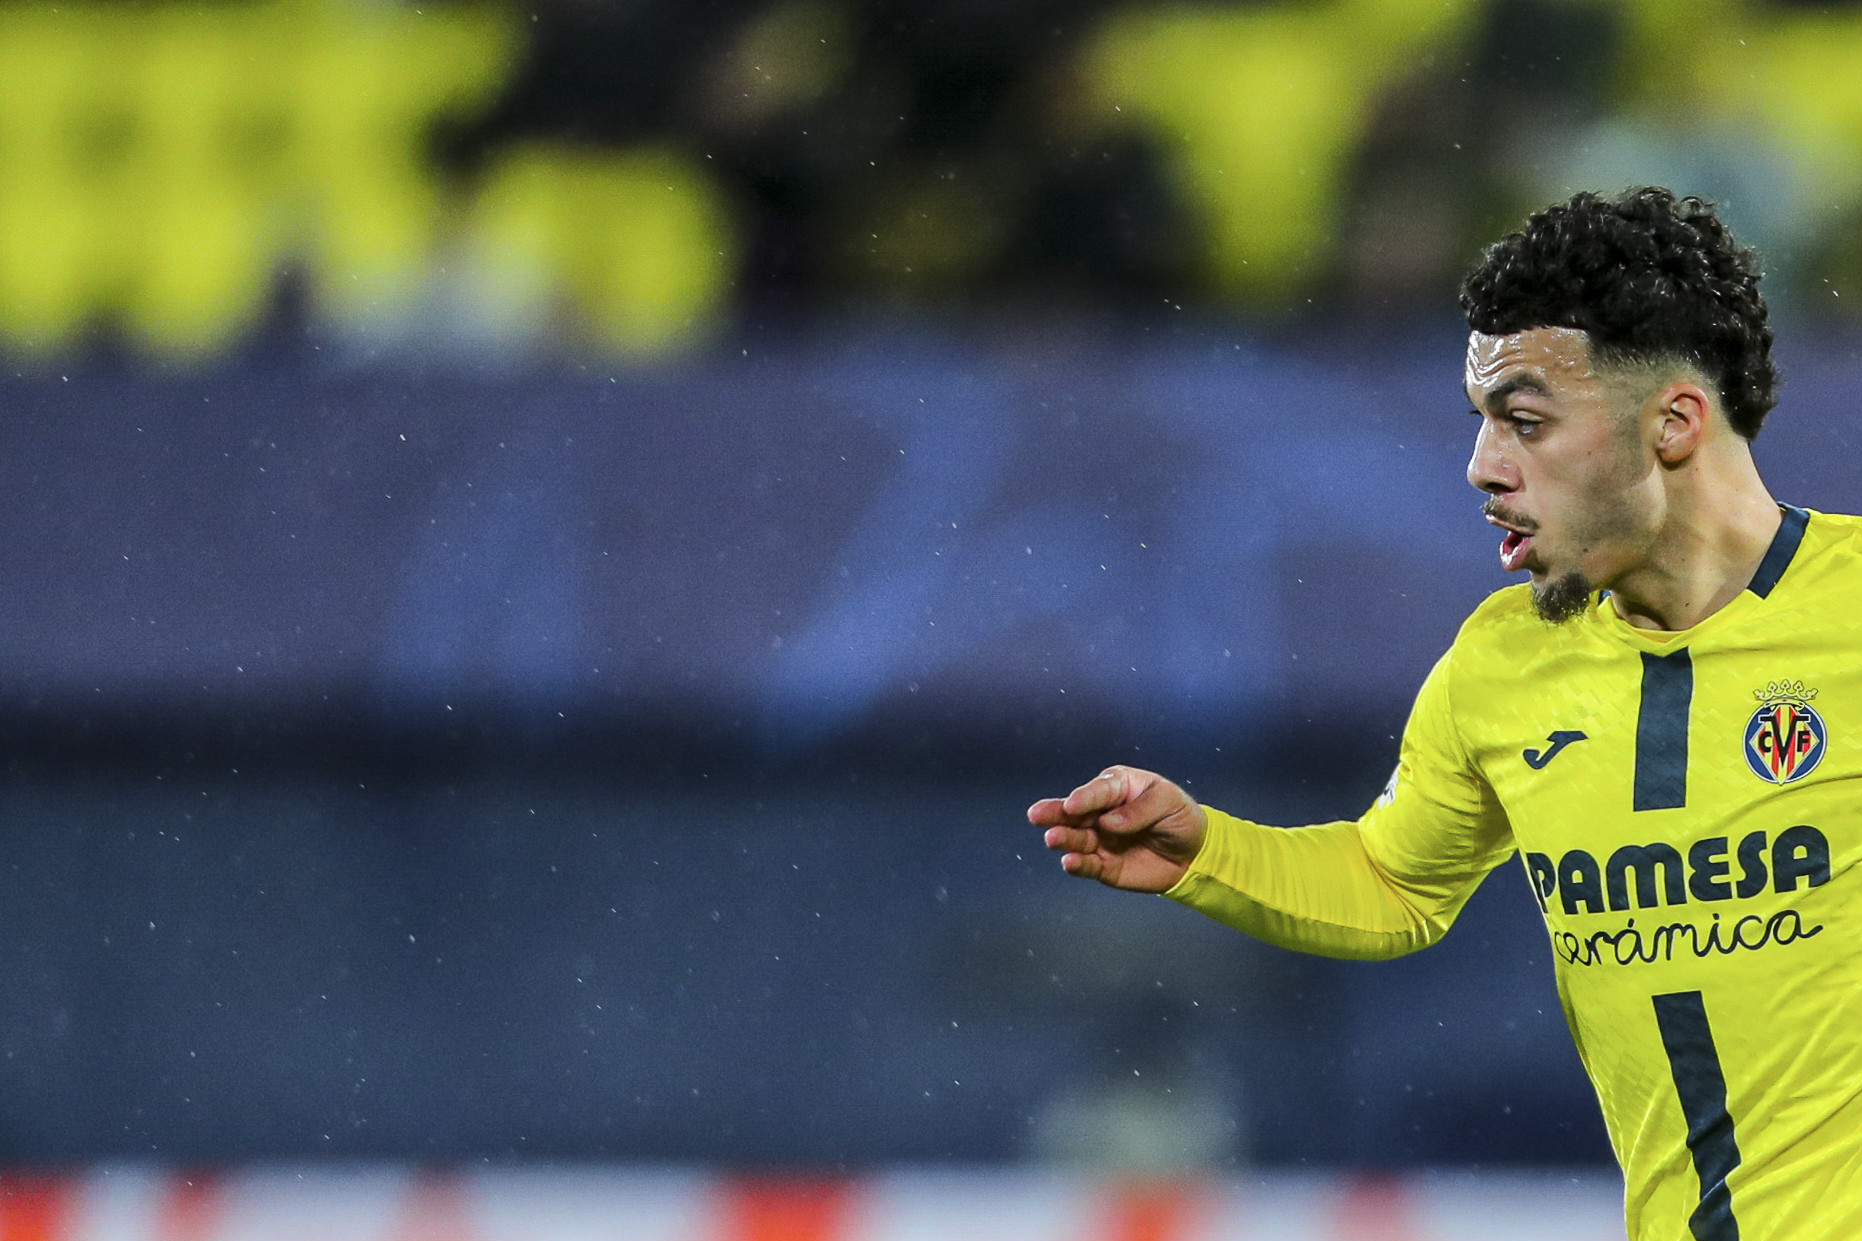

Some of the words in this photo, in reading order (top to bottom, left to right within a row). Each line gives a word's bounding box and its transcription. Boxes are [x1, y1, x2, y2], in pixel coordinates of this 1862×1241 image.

[1757, 714, 1811, 768] CVF
[1525, 825, 1831, 915] PAMESA
[1554, 909, 1824, 967] cerámica
